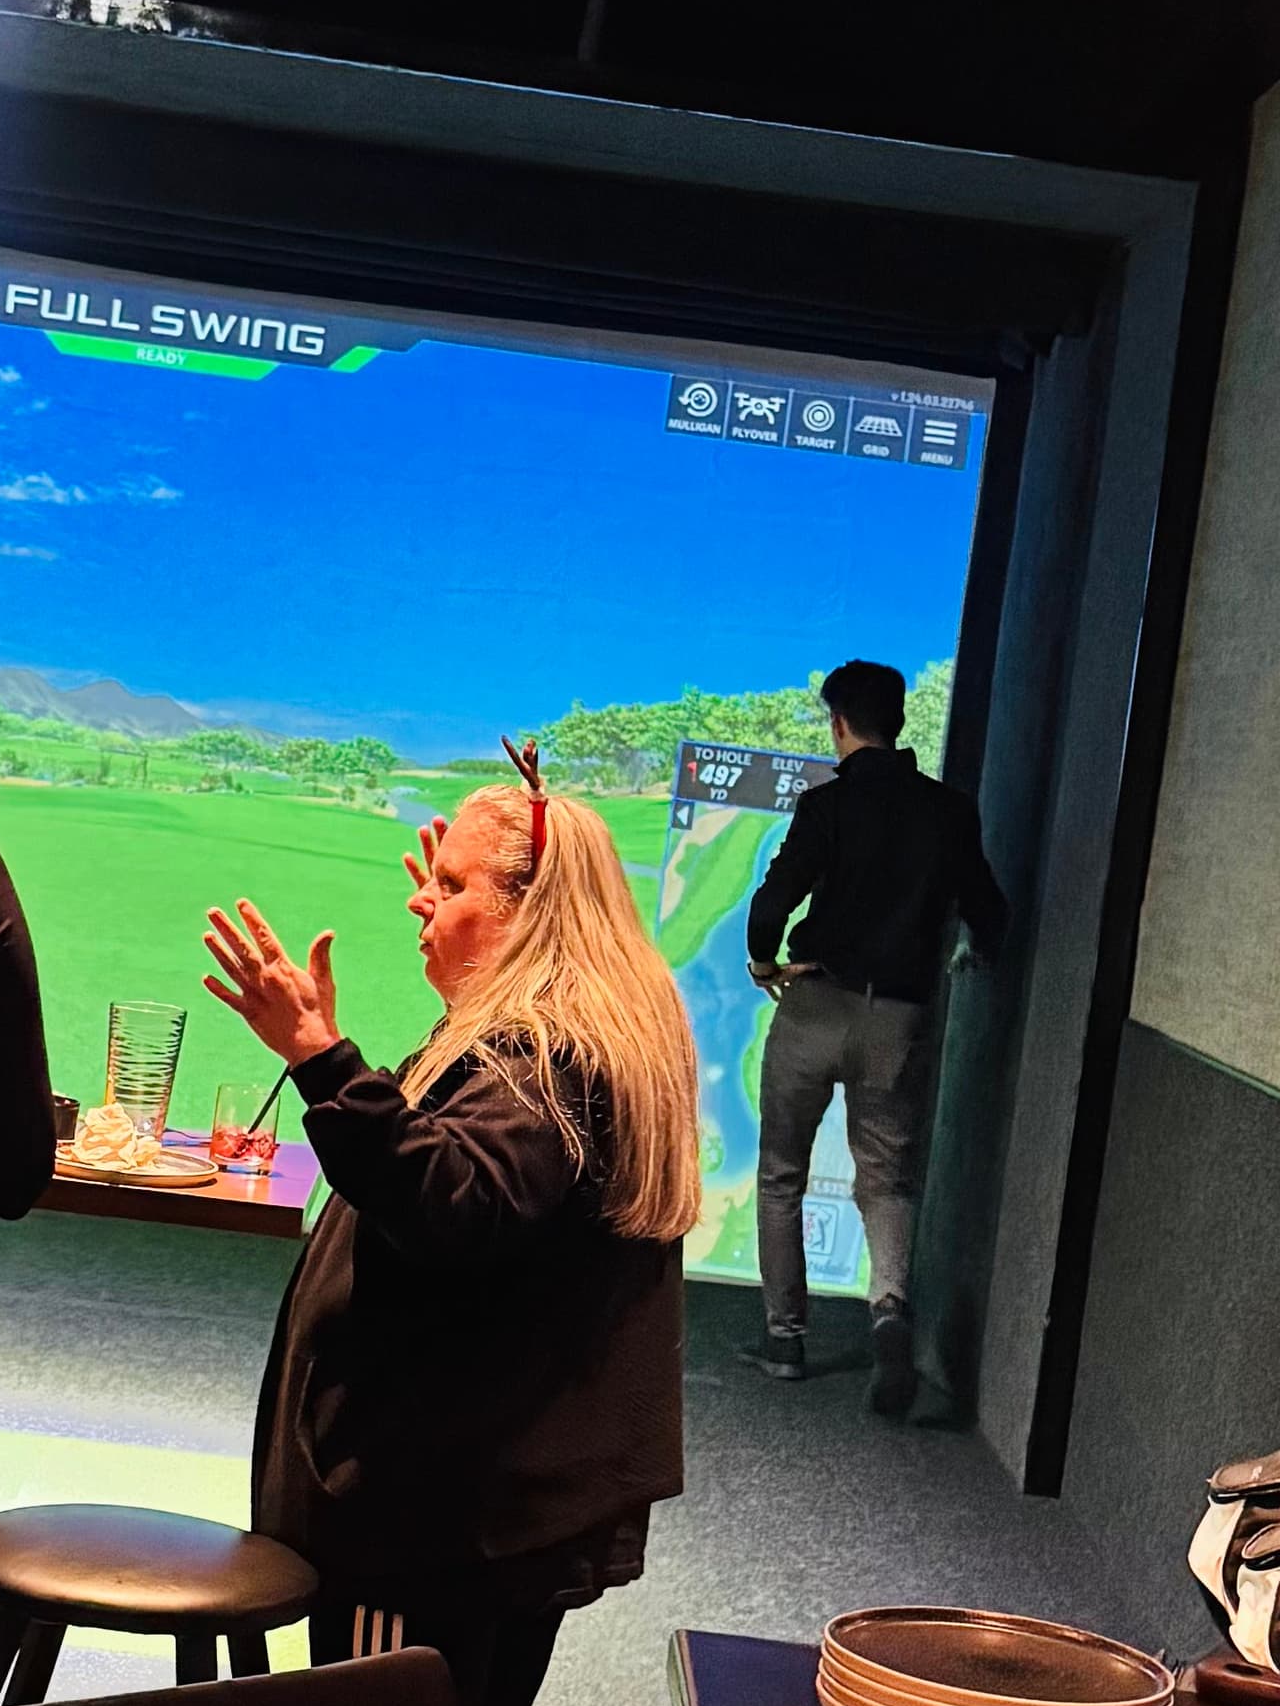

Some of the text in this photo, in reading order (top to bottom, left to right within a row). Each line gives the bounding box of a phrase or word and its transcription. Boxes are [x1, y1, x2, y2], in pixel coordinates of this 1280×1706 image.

[5, 283, 326, 356] FULL SWING
[136, 345, 187, 366] READY
[668, 418, 722, 436] MULLIGAN
[732, 426, 779, 443] FLYOVER
[795, 434, 837, 451] TARGET
[862, 443, 890, 458] GRID
[920, 451, 954, 466] MENU
[694, 746, 753, 767] TO HOLE
[771, 756, 805, 773] ELEV
[698, 763, 743, 788] 497
[774, 774, 792, 795] 5
[709, 787, 728, 801] YD
[774, 796, 793, 810] FT
